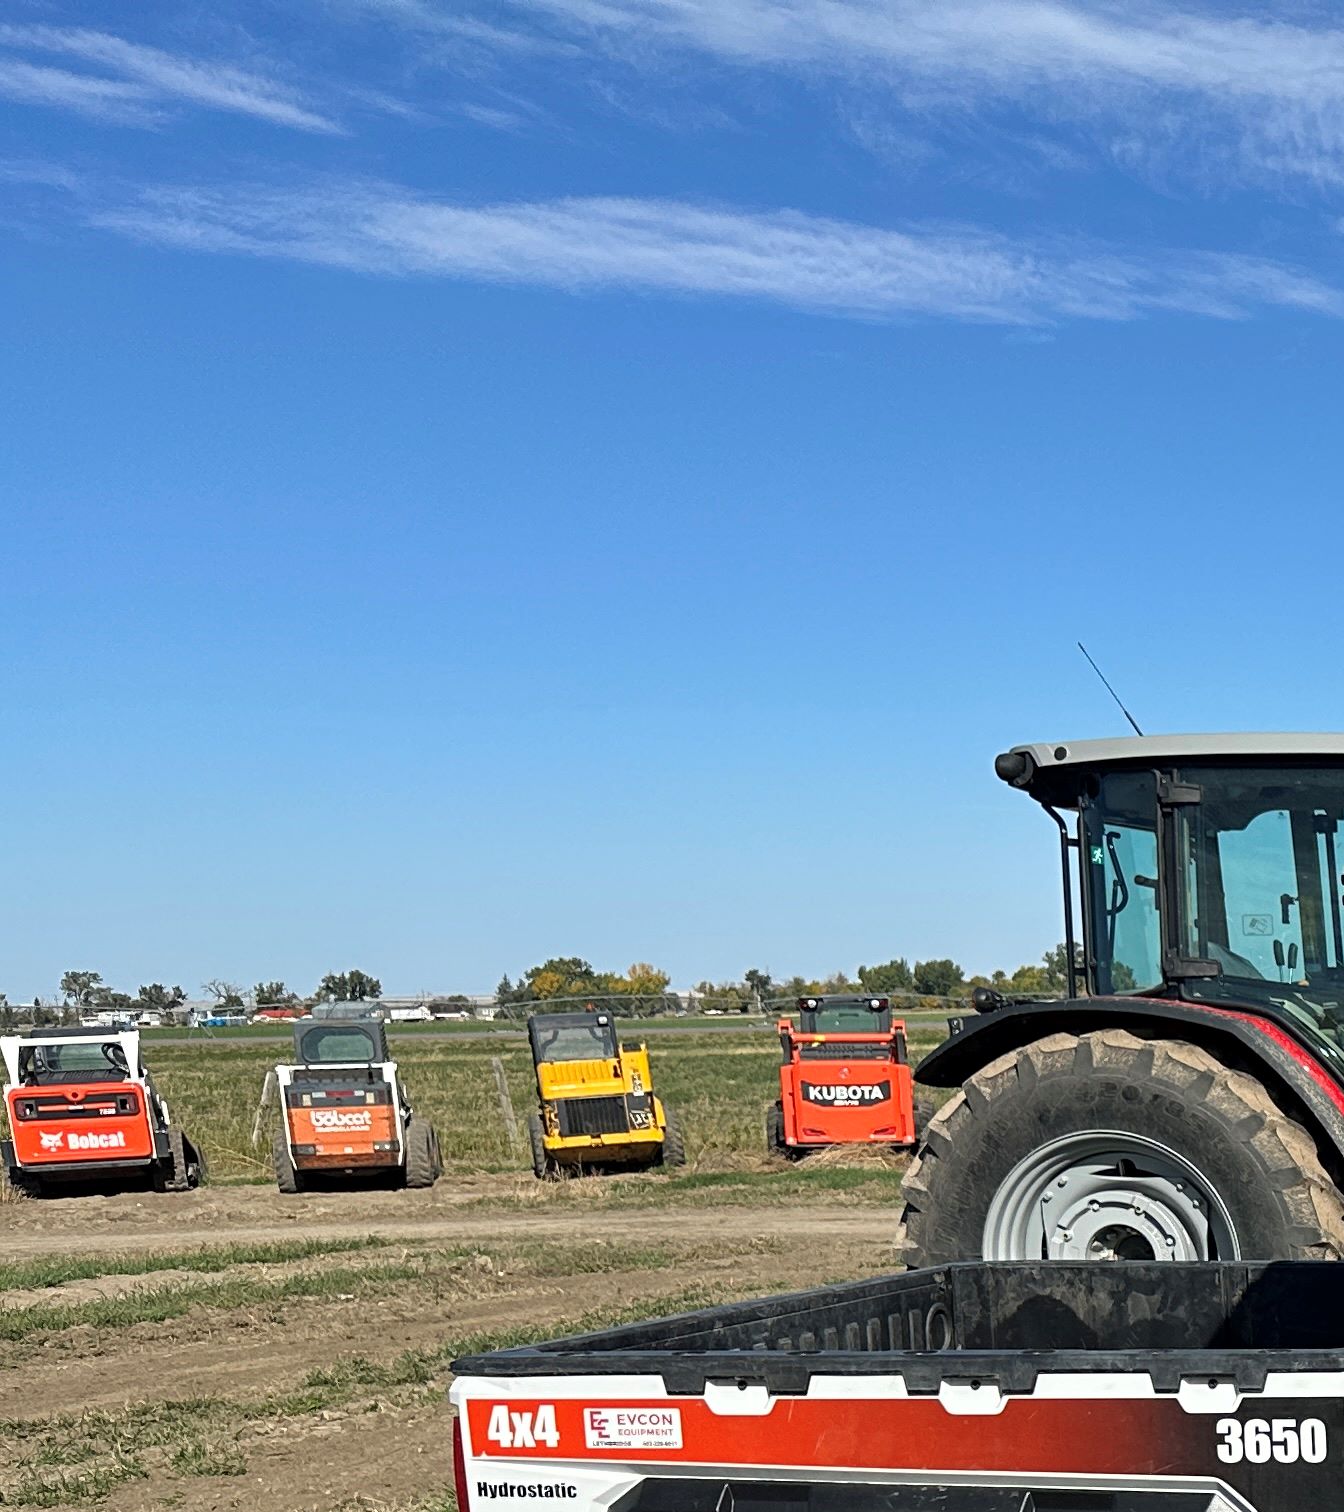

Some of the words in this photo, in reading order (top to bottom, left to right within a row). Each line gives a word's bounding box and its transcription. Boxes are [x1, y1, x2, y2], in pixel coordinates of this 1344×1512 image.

[808, 1085, 884, 1100] KUBOTA
[67, 1131, 126, 1149] Bobcat
[487, 1404, 560, 1448] 4x4
[617, 1413, 673, 1426] EVCON
[617, 1428, 674, 1437] EQUIPMENT
[1216, 1418, 1328, 1464] 3650
[477, 1481, 578, 1499] Hydrostatic
